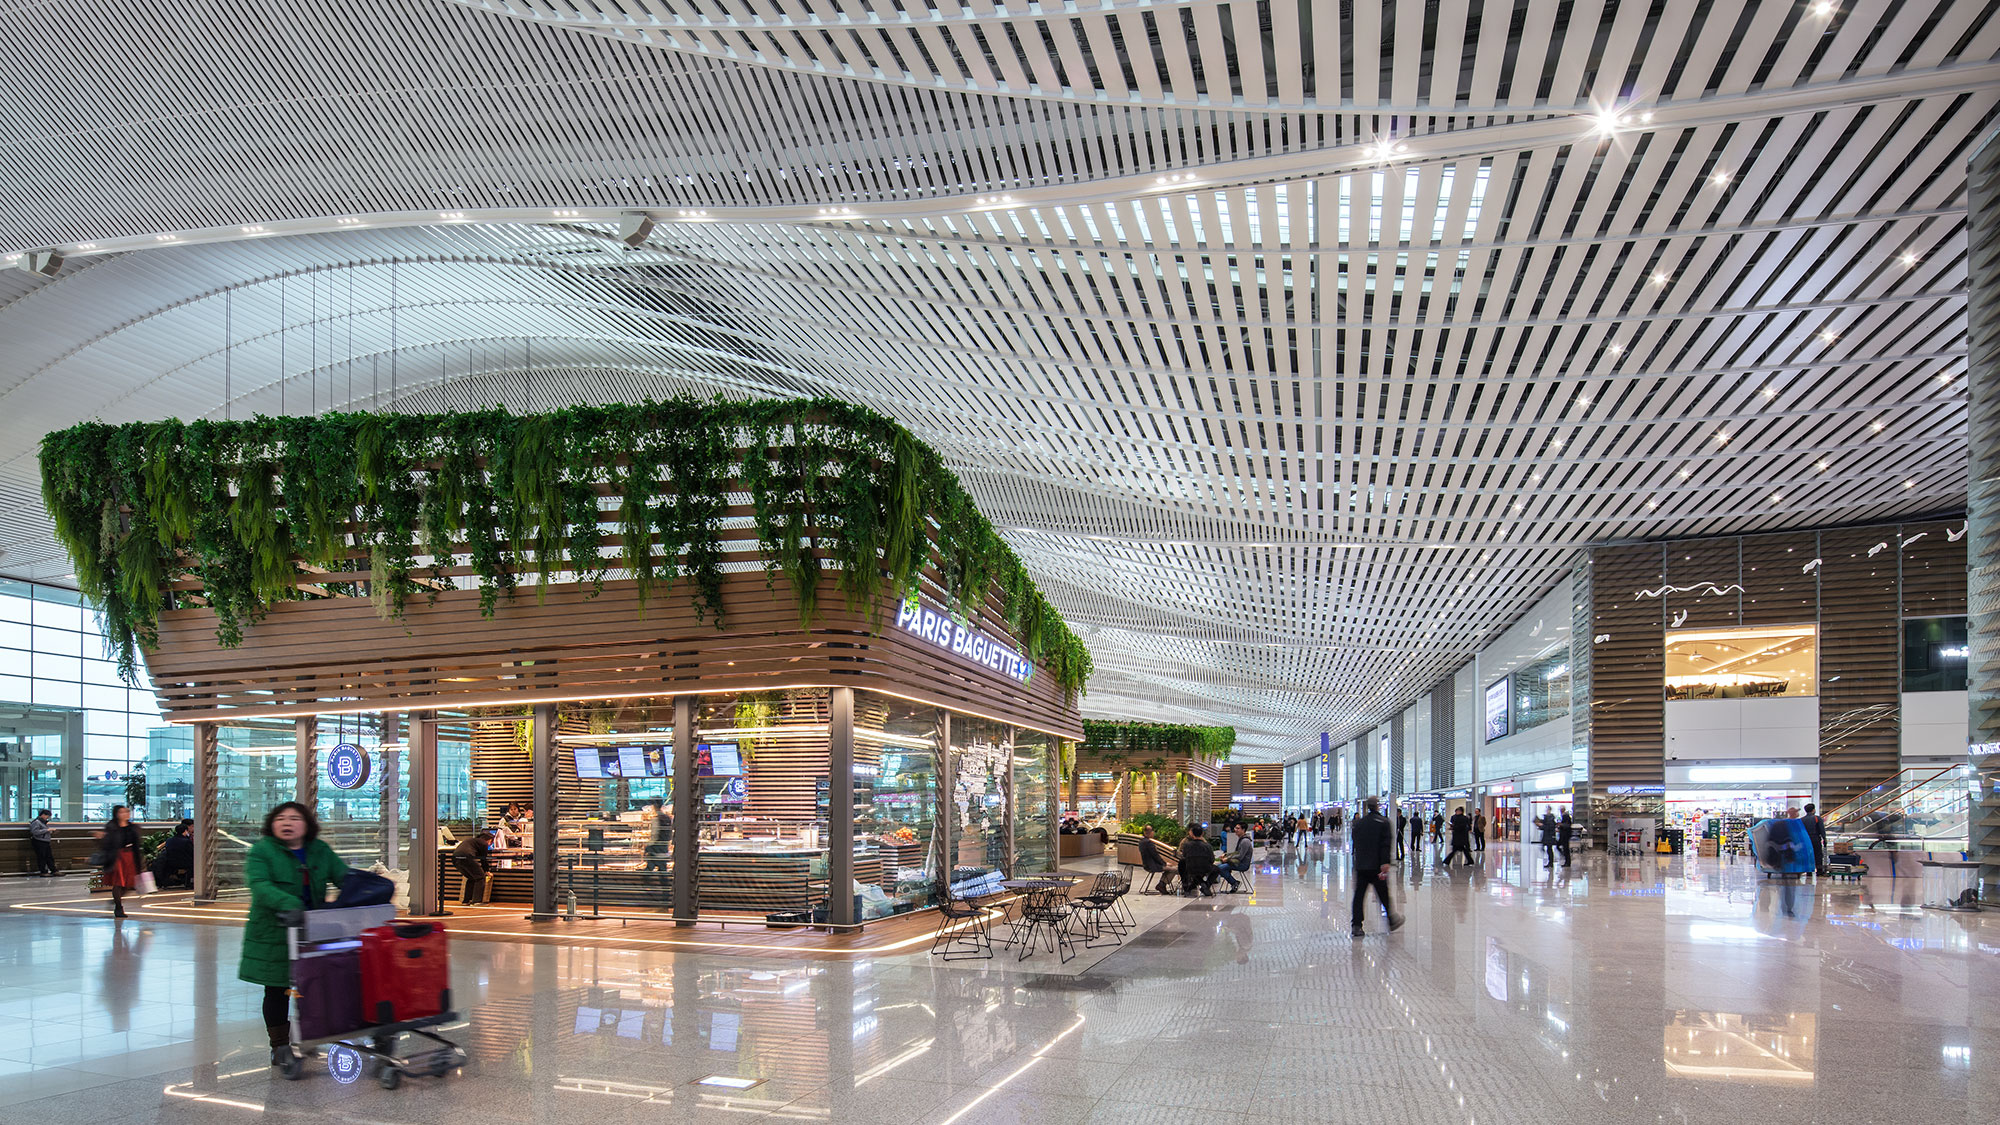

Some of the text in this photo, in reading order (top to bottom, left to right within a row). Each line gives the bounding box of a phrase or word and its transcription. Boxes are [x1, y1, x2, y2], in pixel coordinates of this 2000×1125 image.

[898, 598, 1020, 679] PARIS BAGUETTE
[1322, 753, 1328, 762] 2
[1248, 769, 1257, 783] E
